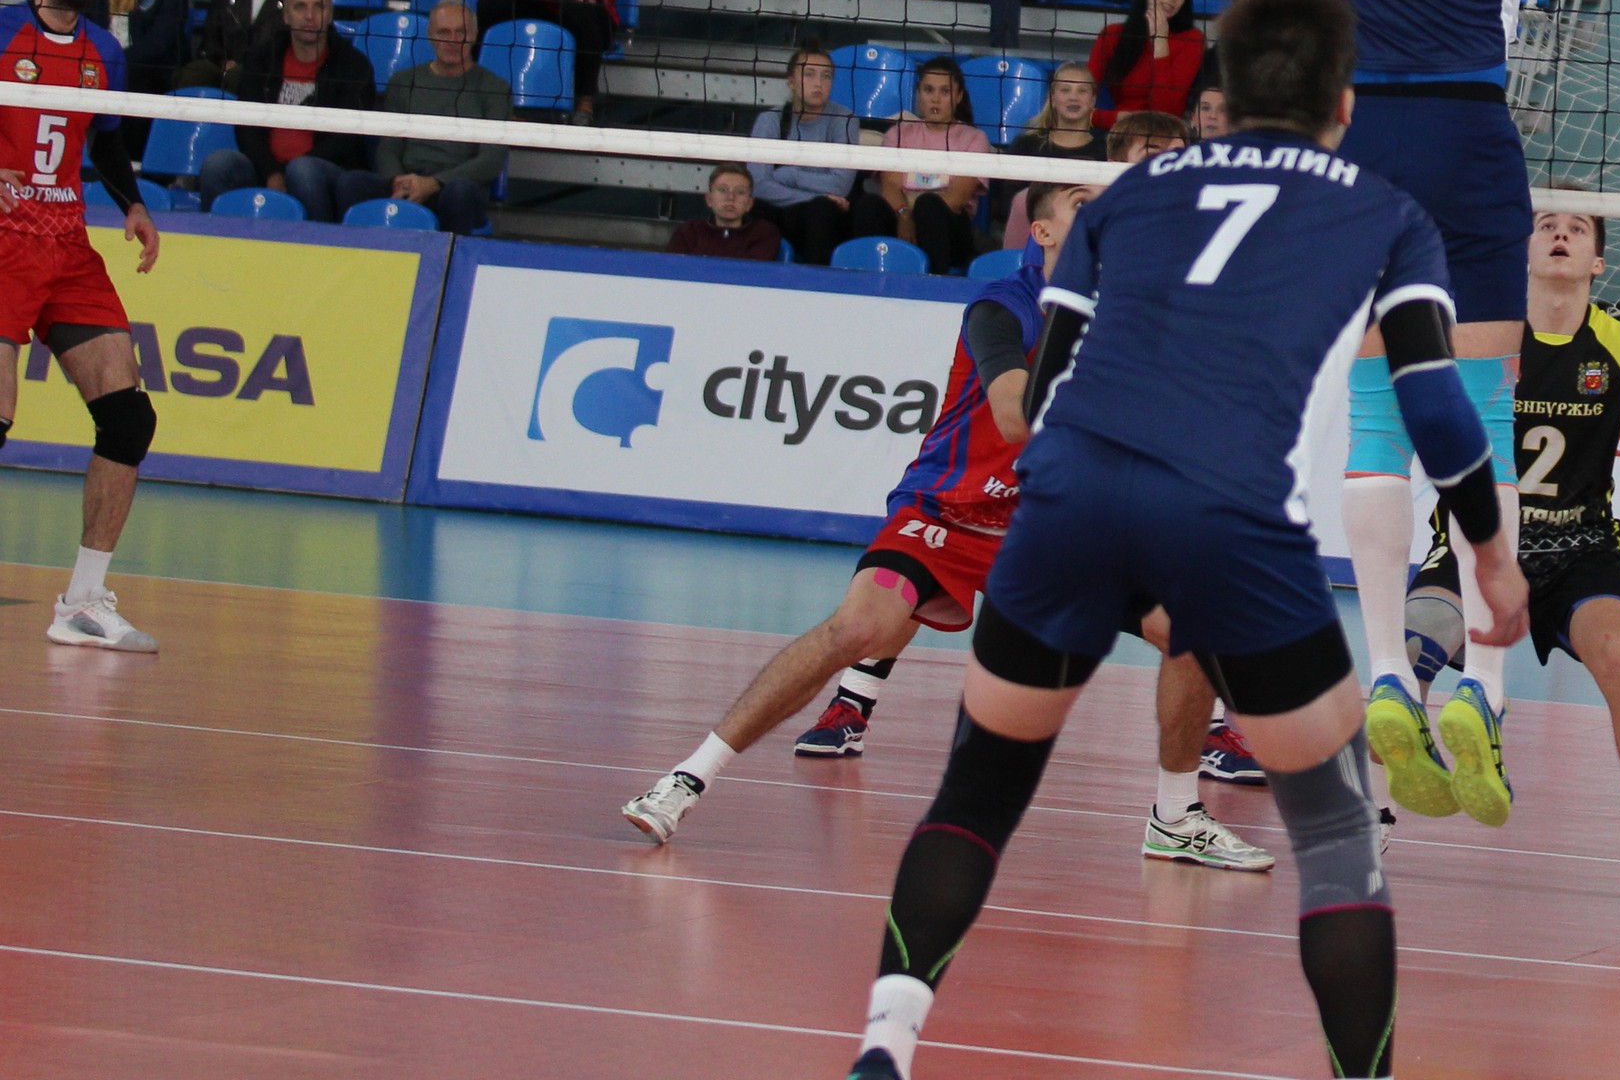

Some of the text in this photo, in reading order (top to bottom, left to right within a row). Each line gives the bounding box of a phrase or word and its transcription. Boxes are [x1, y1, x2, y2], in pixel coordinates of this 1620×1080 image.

[34, 114, 68, 174] 5
[1148, 143, 1360, 187] САХАЛИН
[1184, 183, 1281, 285] 7
[1514, 399, 1605, 418] ЕНБУРЖЬЕ
[1520, 425, 1566, 497] 2
[897, 520, 948, 549] 20
[1420, 545, 1448, 572] 2
